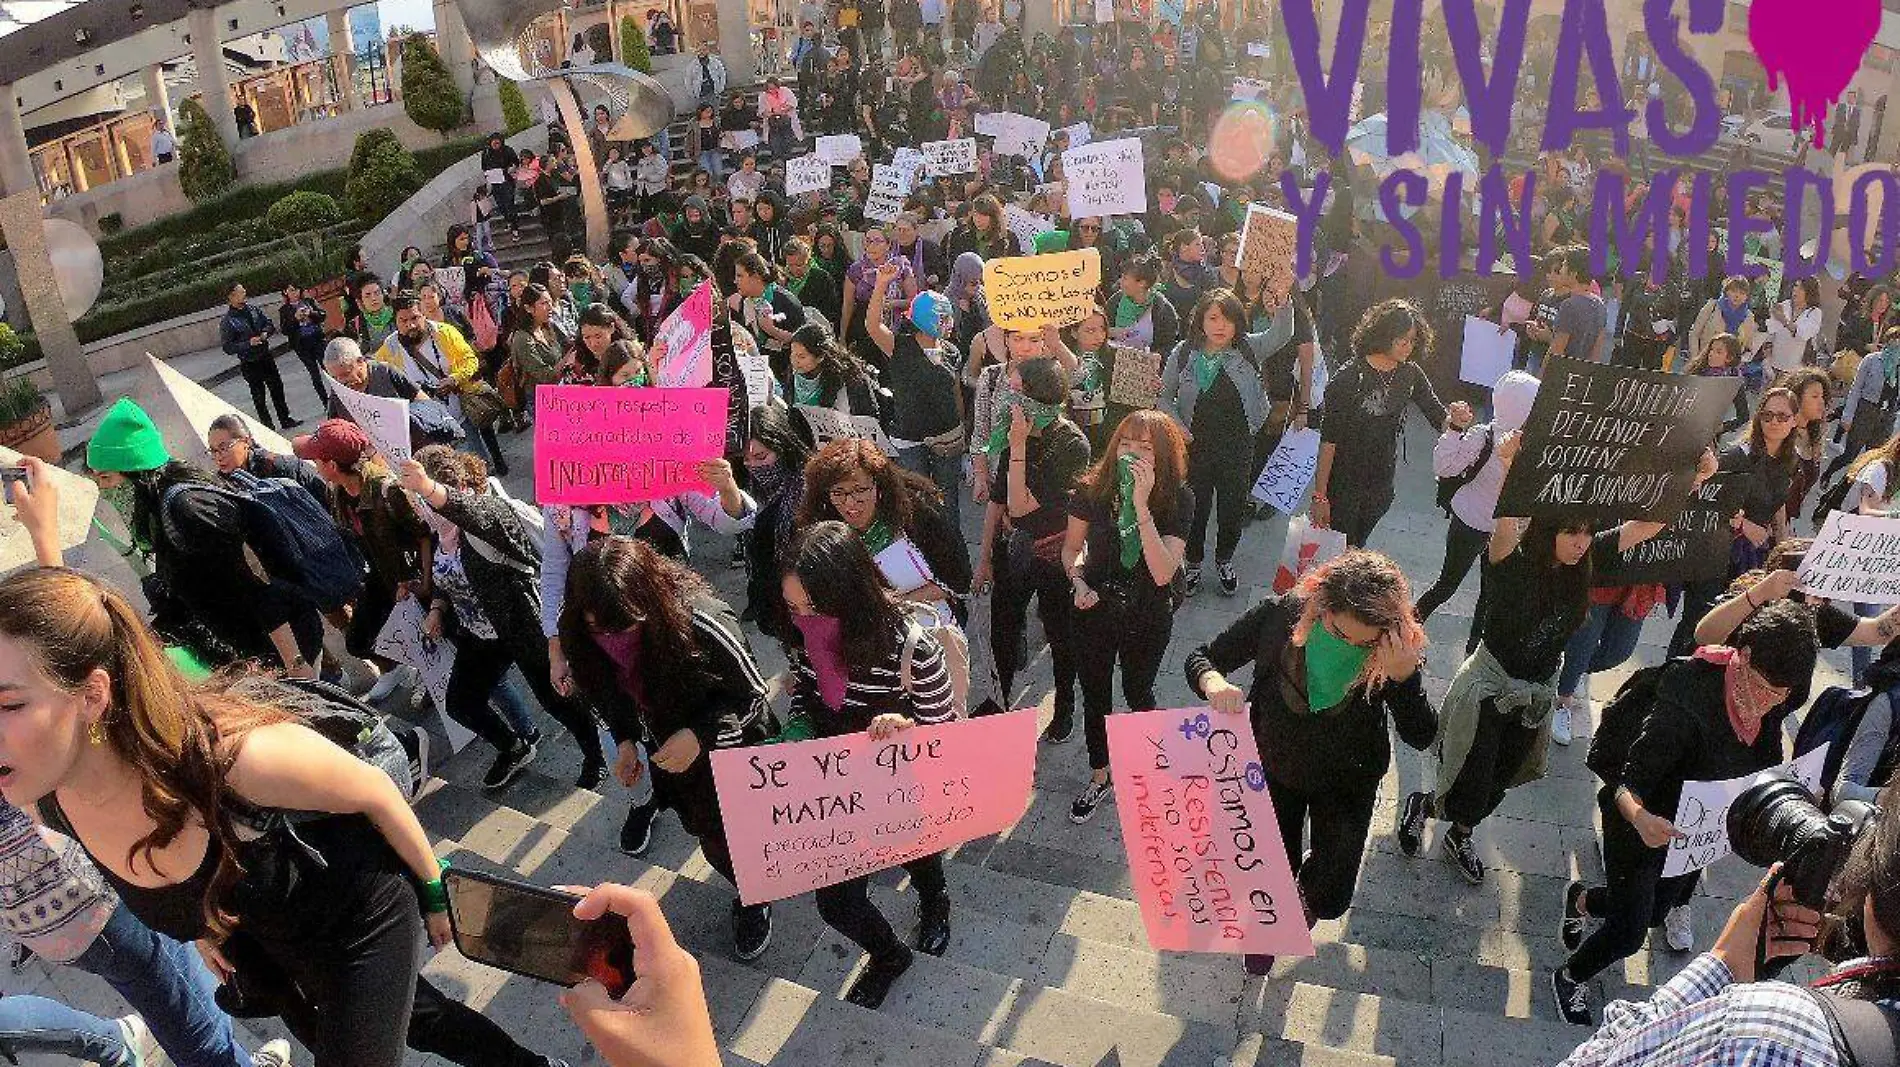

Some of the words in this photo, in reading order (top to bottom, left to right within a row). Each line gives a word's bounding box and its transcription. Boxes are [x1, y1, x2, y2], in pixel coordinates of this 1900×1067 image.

[994, 265, 1069, 288] Somos
[1072, 259, 1085, 278] el
[1016, 305, 1037, 318] NO
[1560, 372, 1595, 406] EL
[1606, 376, 1699, 417] SISTEMA
[1549, 410, 1651, 446] DEFIENDE
[1658, 424, 1676, 447] Y
[1535, 444, 1629, 470] SOSTIENE
[1534, 472, 1674, 511] ASESINOS
[1850, 531, 1873, 551] LO
[1826, 551, 1849, 570] LAS
[749, 755, 788, 790] Se
[812, 748, 851, 779] ve
[875, 738, 943, 776] que
[1146, 735, 1170, 770] ya
[772, 791, 866, 825] MATAR
[886, 783, 925, 806] no
[942, 776, 971, 797] es
[1161, 787, 1181, 826] no
[763, 828, 856, 861] pecado
[875, 806, 974, 836] cuando
[1131, 774, 1181, 920] indefensas
[1170, 841, 1212, 926] somos
[1248, 888, 1278, 926] en
